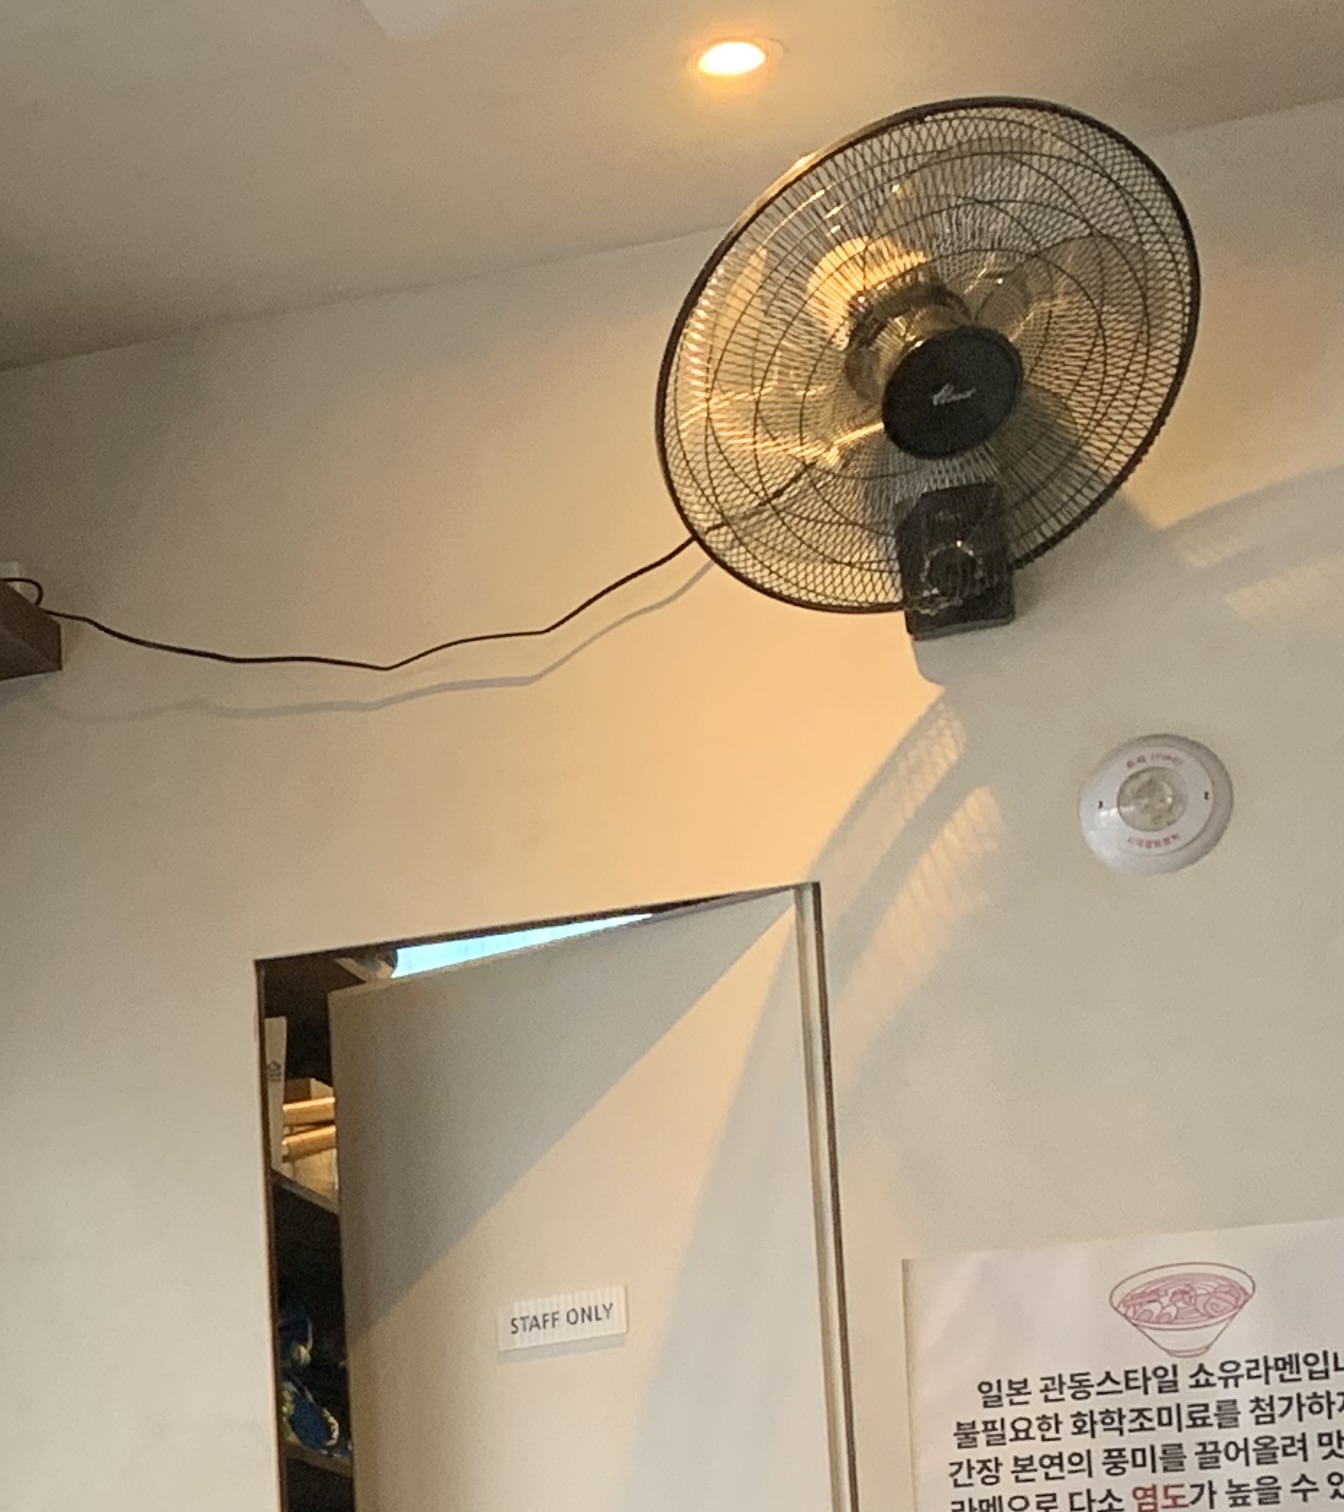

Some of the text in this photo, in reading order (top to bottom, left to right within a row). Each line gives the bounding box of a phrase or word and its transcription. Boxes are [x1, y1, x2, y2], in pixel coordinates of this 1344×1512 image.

[510, 1302, 613, 1335] STAFF ONLY
[977, 1377, 1032, 1409] 일본
[1039, 1363, 1180, 1404] 관동스타일
[953, 1412, 1063, 1450] 불필요한
[1070, 1398, 1242, 1440] 화학조미료를
[948, 1456, 1004, 1489] 간장
[1010, 1449, 1094, 1484] 본연의
[1101, 1442, 1187, 1477] 풍미를
[1194, 1431, 1309, 1470] 끌어올려
[1225, 1474, 1282, 1509] 높을
[1290, 1472, 1319, 1503] 수
